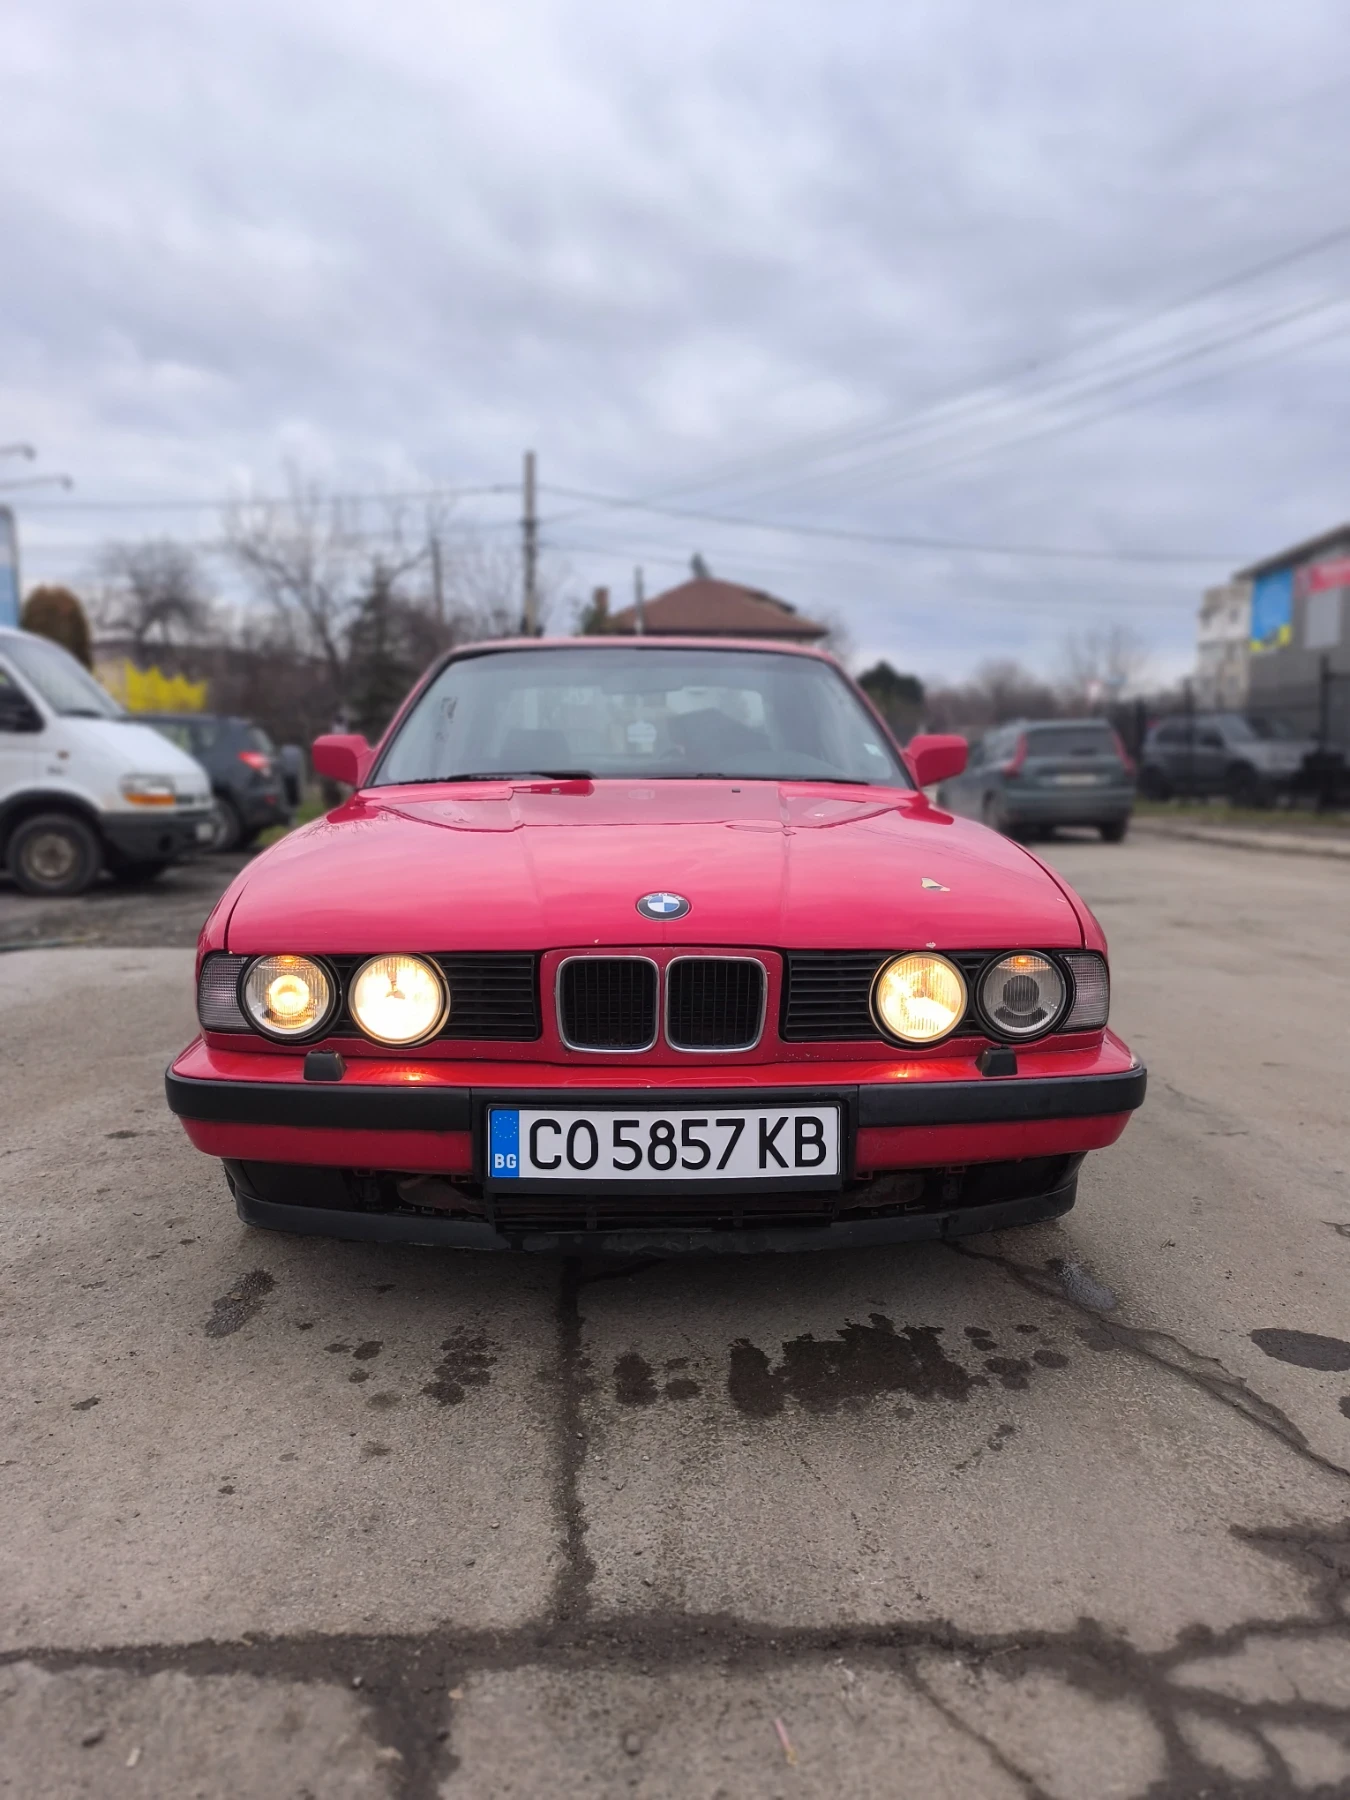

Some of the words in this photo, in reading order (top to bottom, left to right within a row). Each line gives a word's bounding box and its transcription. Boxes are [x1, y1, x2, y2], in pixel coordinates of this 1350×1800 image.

[612, 1118, 746, 1171] 5857
[758, 1116, 827, 1169] KB
[494, 1154, 517, 1169] BG
